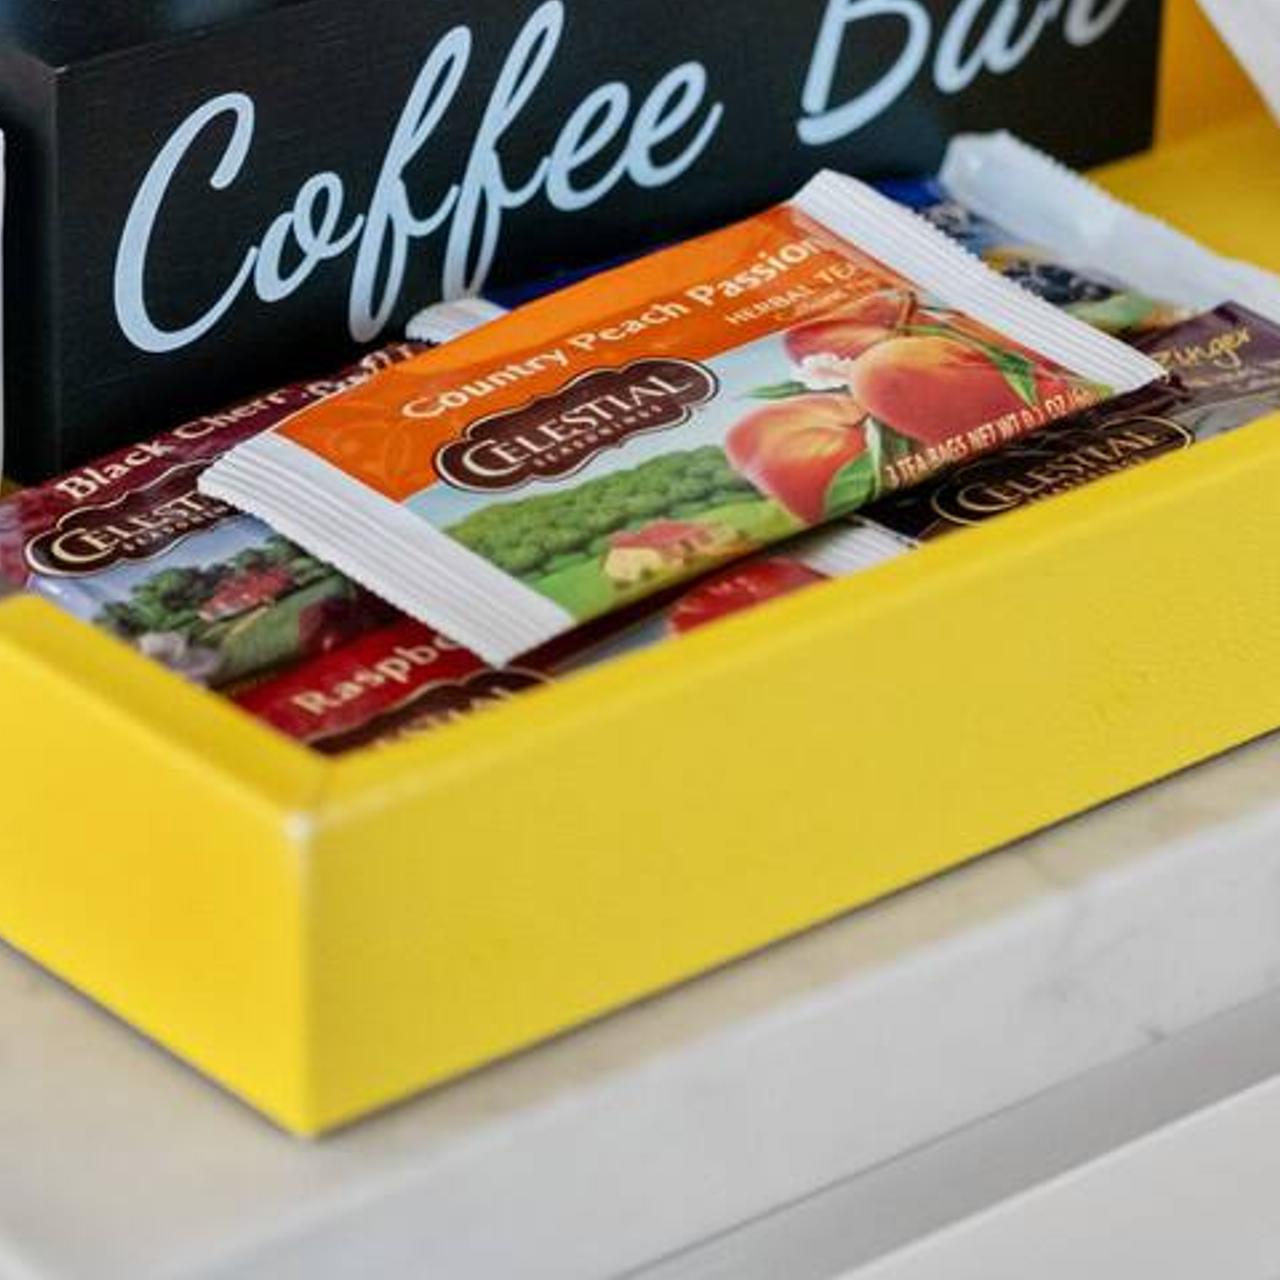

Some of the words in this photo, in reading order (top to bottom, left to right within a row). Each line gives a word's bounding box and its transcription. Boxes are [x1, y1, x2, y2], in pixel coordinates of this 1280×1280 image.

[402, 342, 569, 420] Country
[568, 298, 690, 355] Peach
[684, 234, 827, 307] Passion
[723, 281, 815, 325] HERBAL
[55, 436, 175, 502] Black
[174, 391, 290, 443] Cherr
[461, 374, 692, 477] CELESTIAL
[50, 489, 211, 564] CELEST
[291, 633, 457, 716] Raspbe
